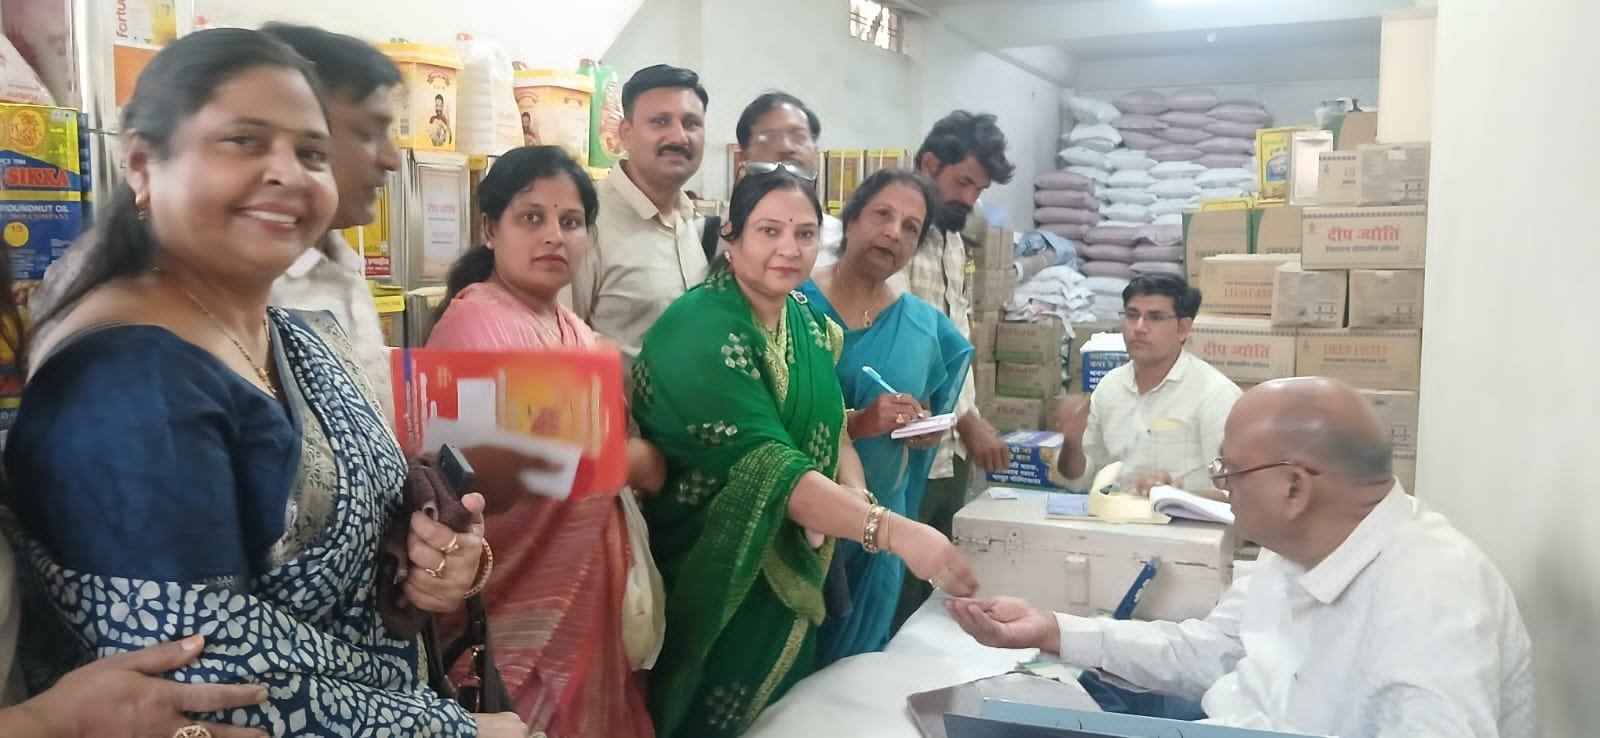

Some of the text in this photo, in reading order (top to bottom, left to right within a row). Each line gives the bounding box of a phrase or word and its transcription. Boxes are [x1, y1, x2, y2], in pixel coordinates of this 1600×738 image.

[5, 167, 71, 188] SIKKA
[1327, 224, 1401, 242] दीप ज्योति
[1203, 342, 1227, 356] दीप
